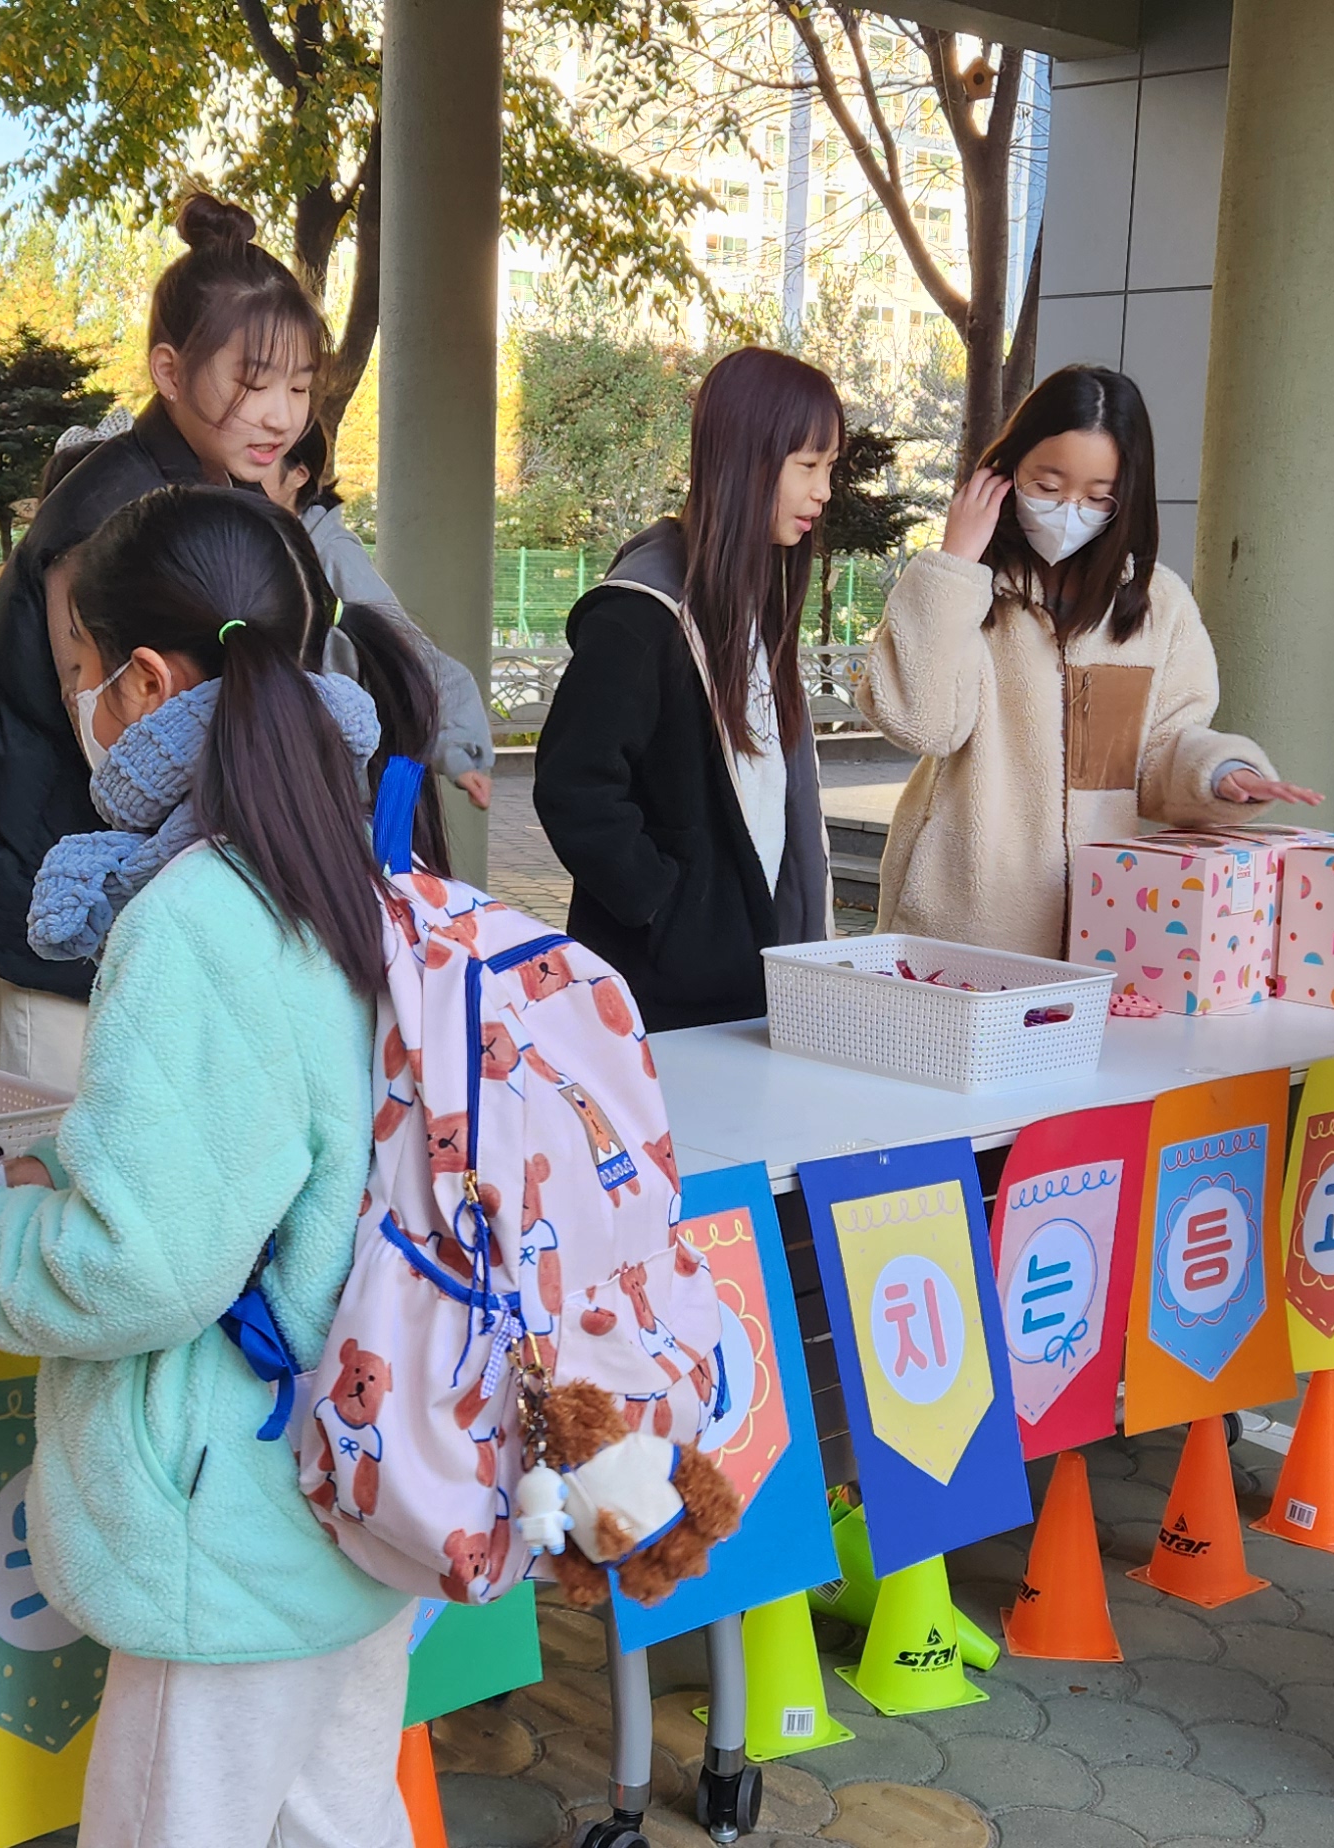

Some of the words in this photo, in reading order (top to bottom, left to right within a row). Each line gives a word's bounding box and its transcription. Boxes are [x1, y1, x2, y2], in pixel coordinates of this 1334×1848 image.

[1182, 1207, 1233, 1291] 등
[884, 1278, 947, 1376] 치
[1021, 1254, 1074, 1335] 는
